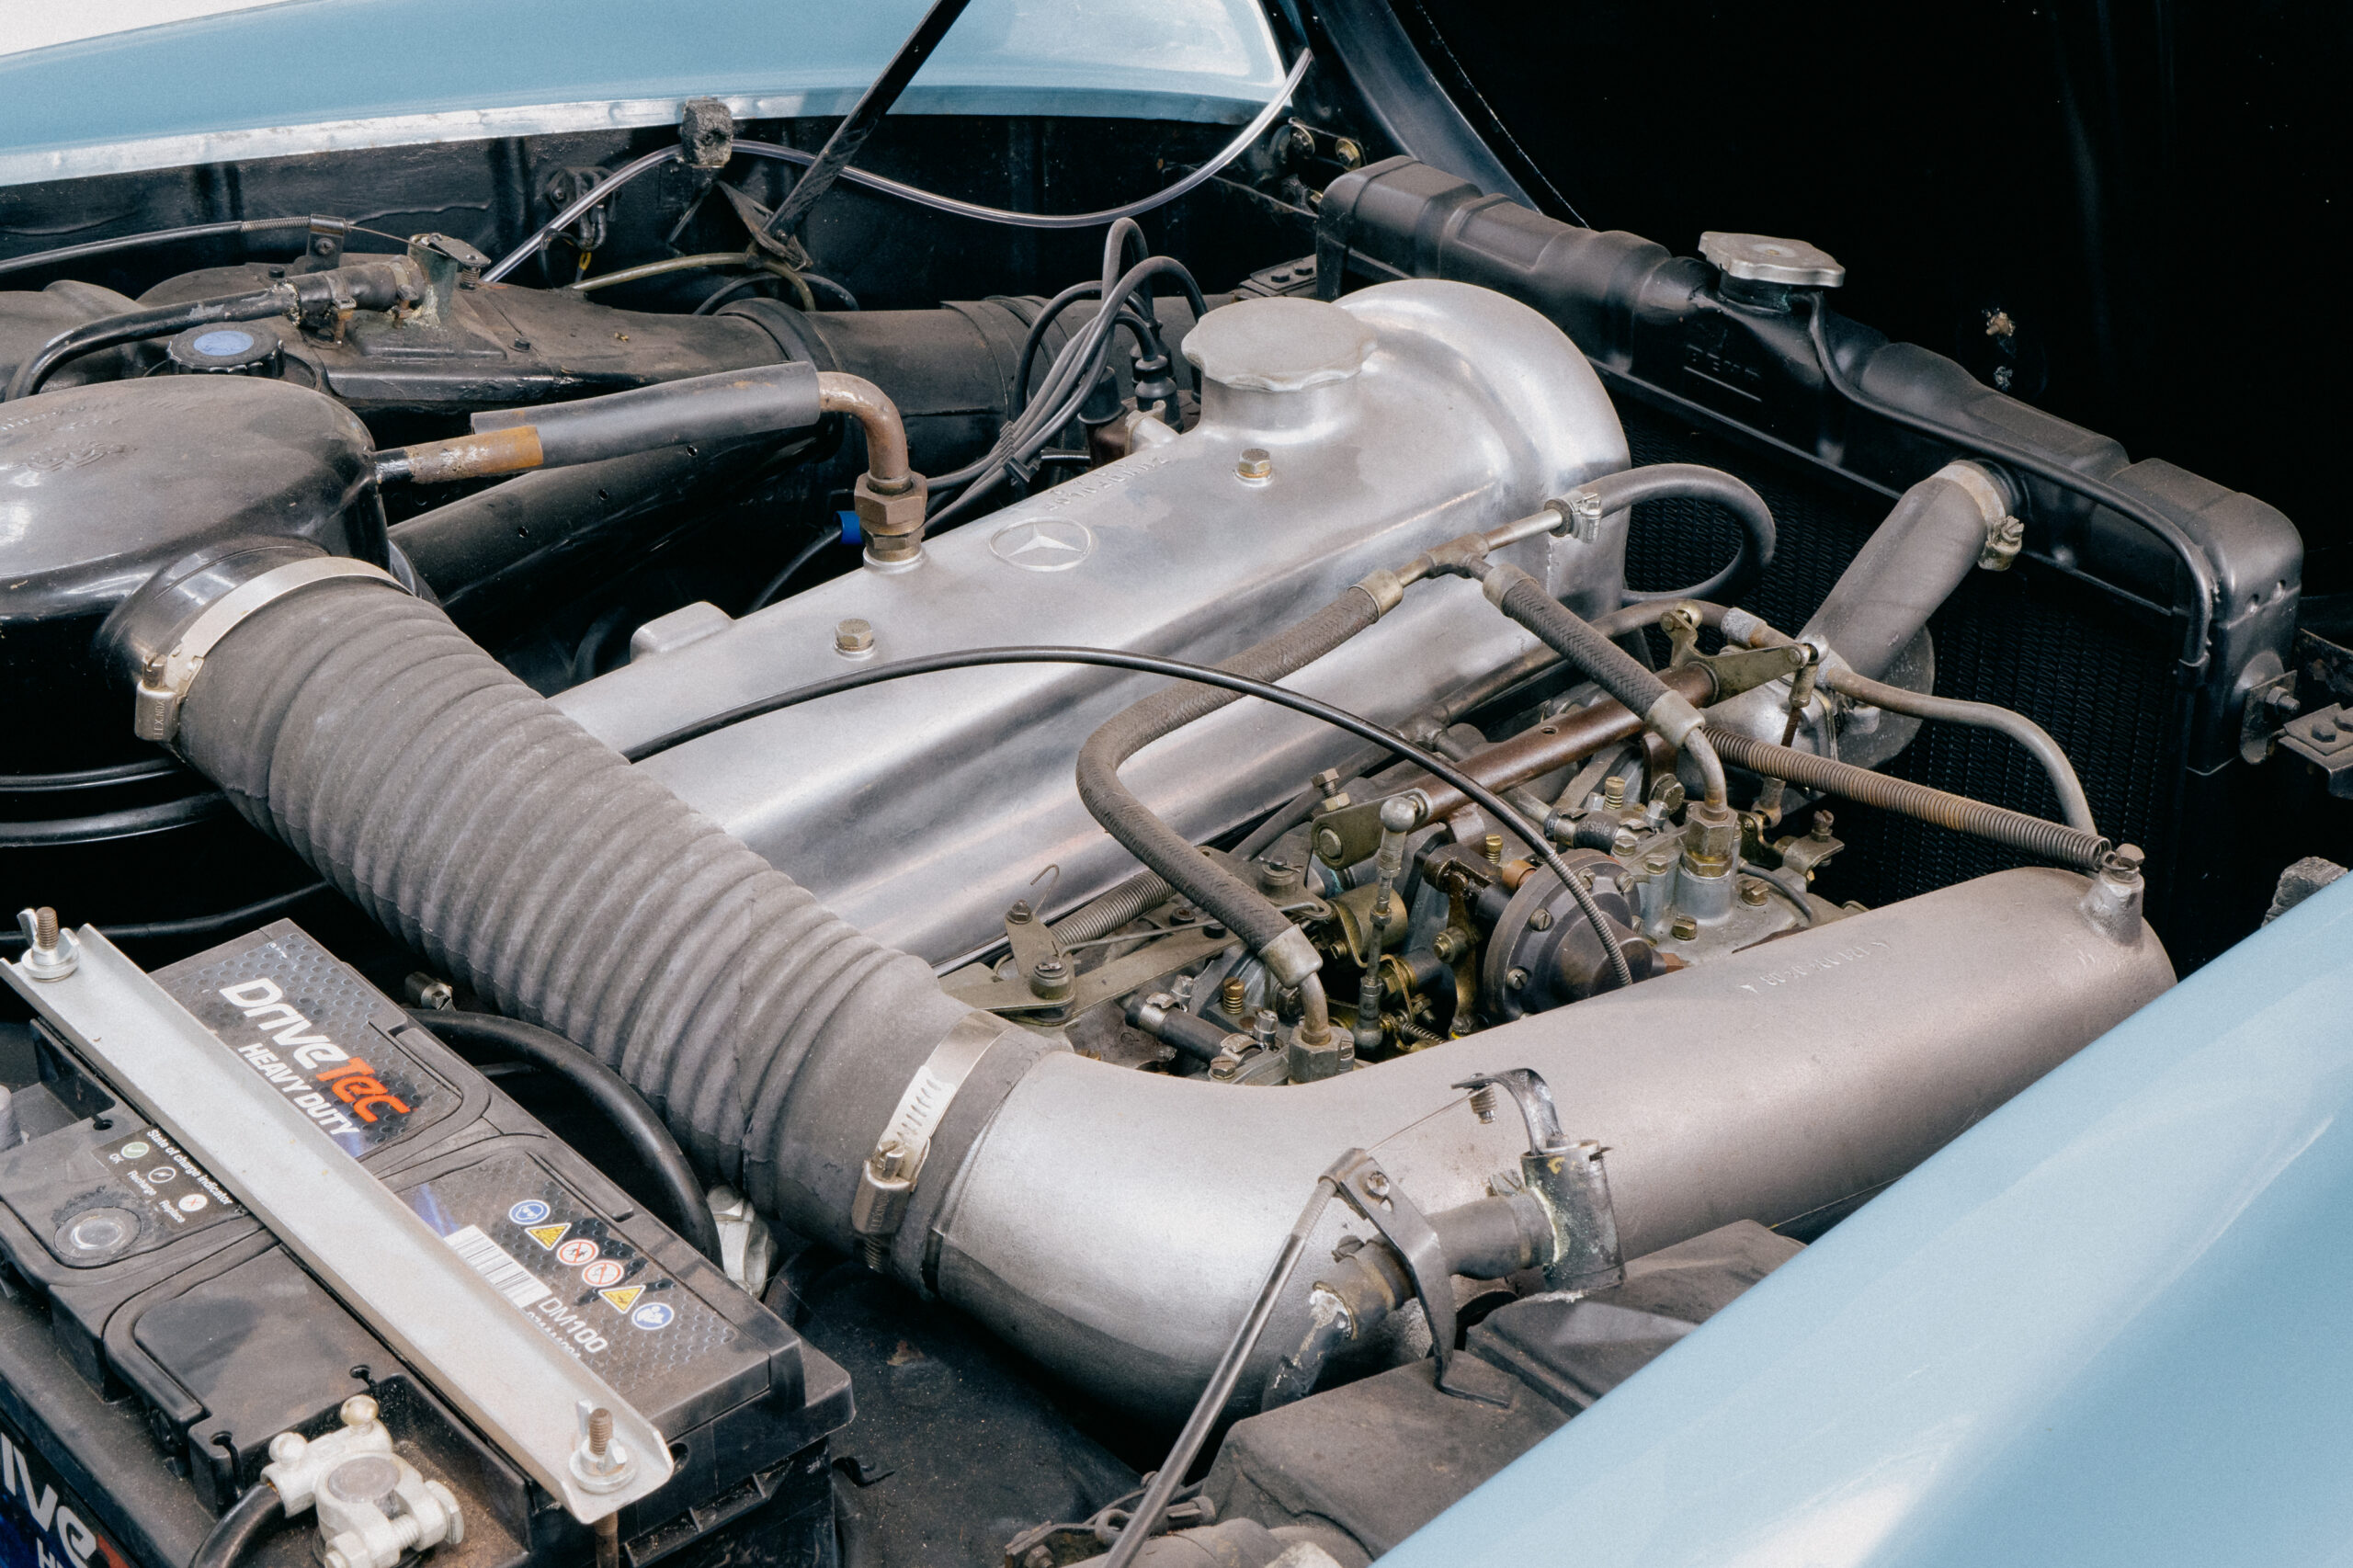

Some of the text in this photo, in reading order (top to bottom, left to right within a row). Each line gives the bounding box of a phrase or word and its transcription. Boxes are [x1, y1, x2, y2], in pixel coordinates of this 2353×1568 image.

[238, 1042, 360, 1135] HEAVY DUTY
[108, 1153, 125, 1165] OK
[147, 1129, 233, 1206] State of charge indicator
[538, 1297, 608, 1353] DM100
